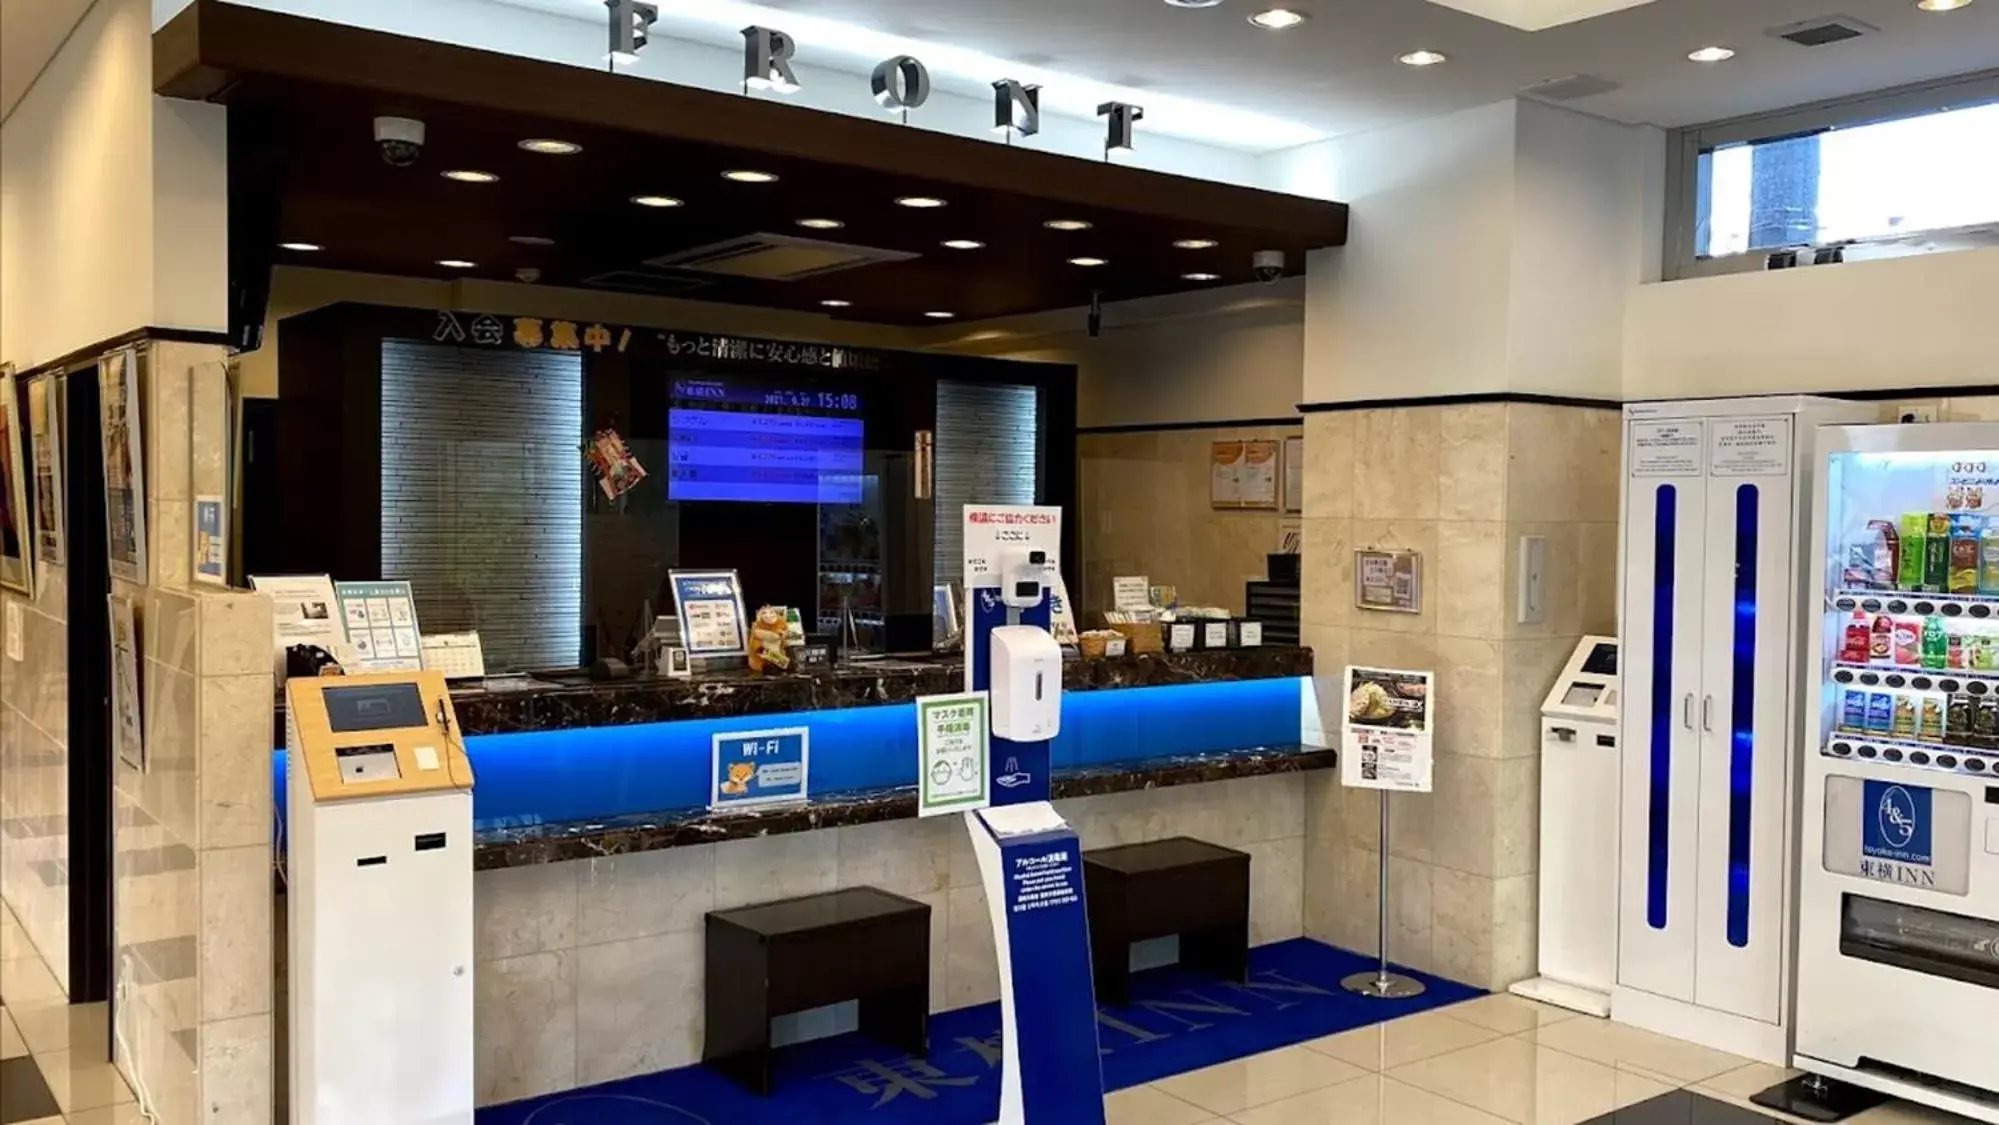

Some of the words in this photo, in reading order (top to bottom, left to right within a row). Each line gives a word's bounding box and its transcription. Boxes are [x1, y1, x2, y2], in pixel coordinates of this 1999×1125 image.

[603, 0, 1144, 151] FRONT
[817, 392, 858, 410] 15:08
[742, 739, 780, 757] Wi-Fi
